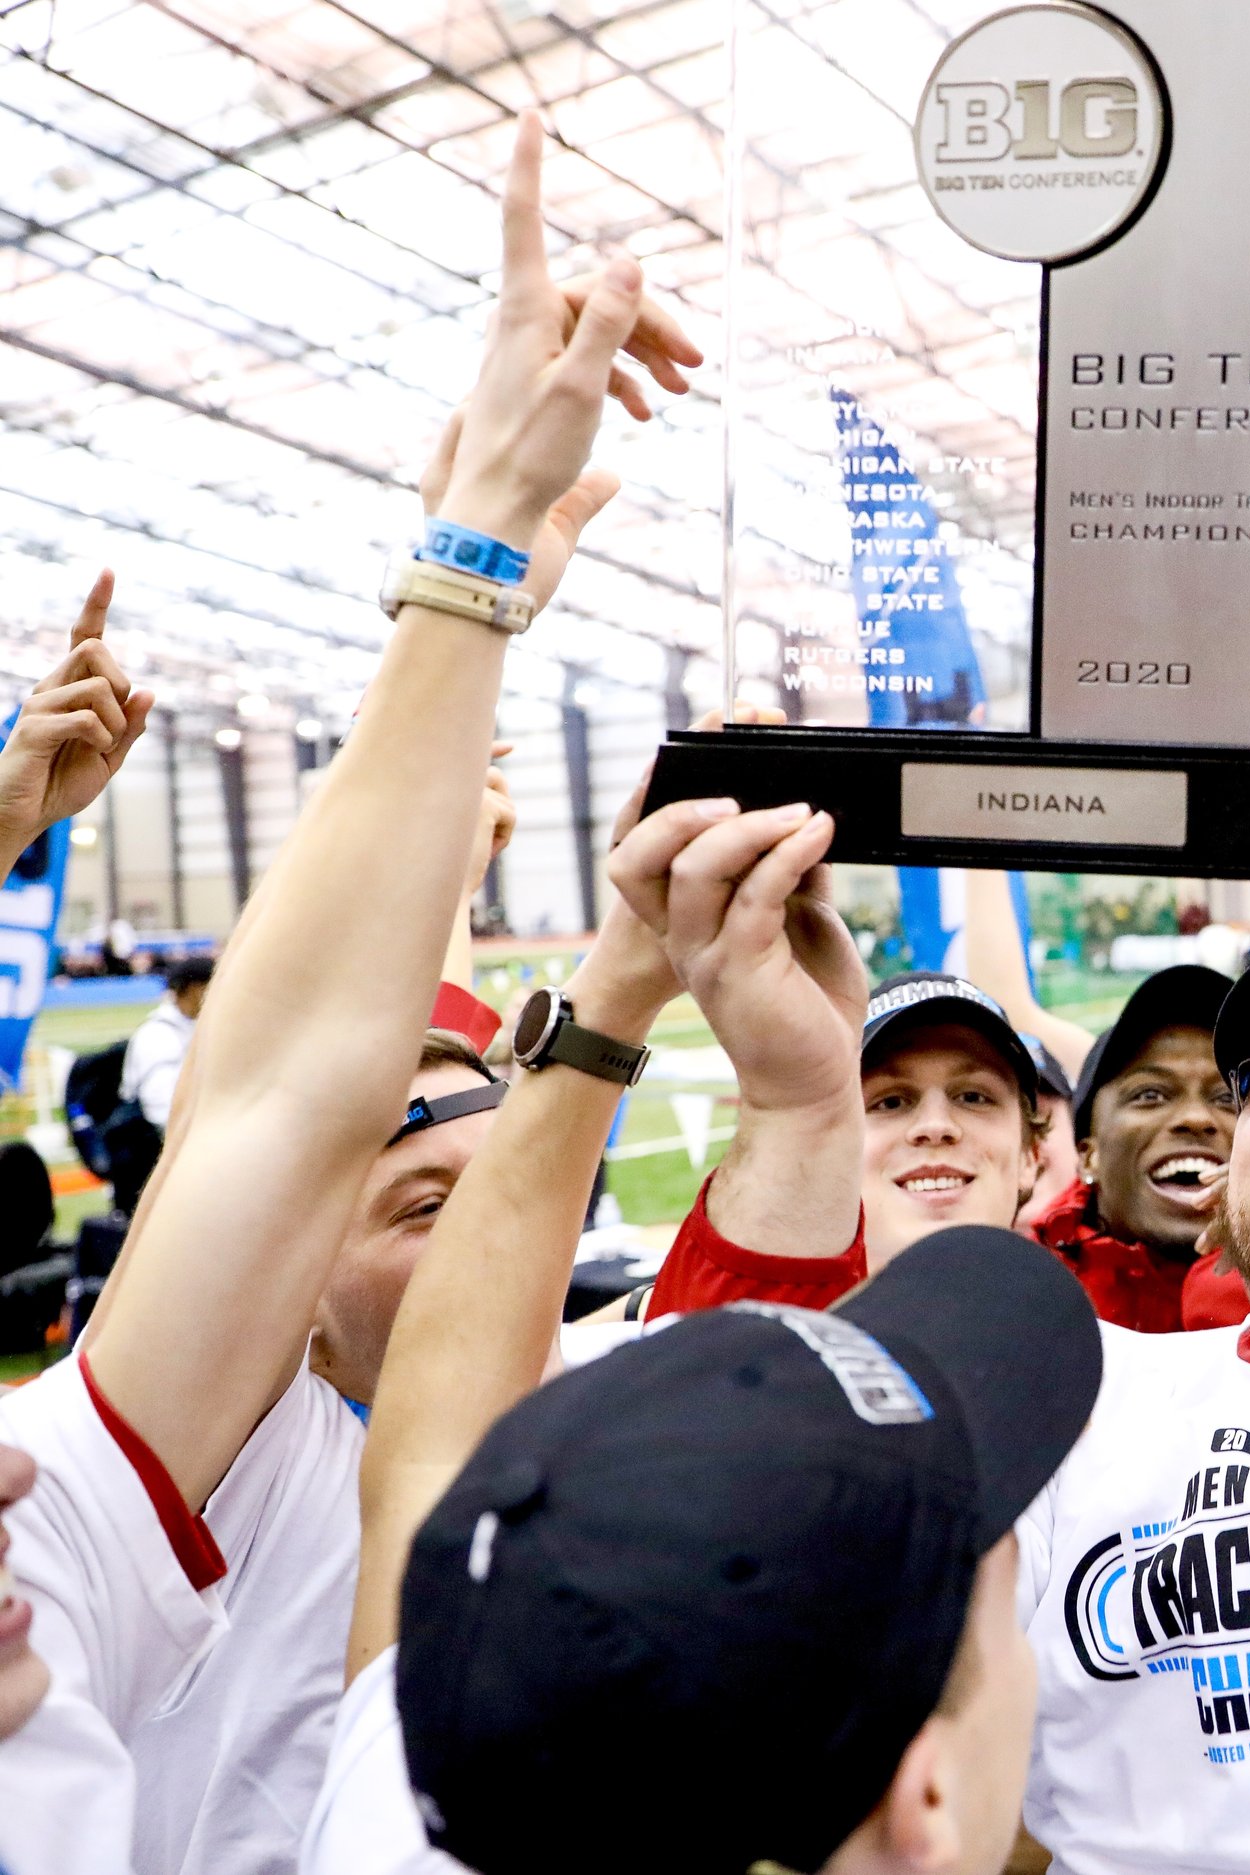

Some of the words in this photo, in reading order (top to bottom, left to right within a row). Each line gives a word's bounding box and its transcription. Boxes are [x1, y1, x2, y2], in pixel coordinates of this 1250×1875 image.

[934, 174, 966, 191] BIG
[968, 174, 1005, 190] TEN
[1008, 170, 1138, 190] CONFERENCE
[1072, 353, 1175, 386] BIG
[928, 456, 1007, 474] STATE
[1145, 491, 1225, 510] INDOOR
[862, 566, 940, 584] STATE
[866, 593, 944, 611] STATE
[783, 646, 905, 665] RUTGERS
[1077, 660, 1192, 686] 2020
[977, 791, 1108, 815] INDIANA
